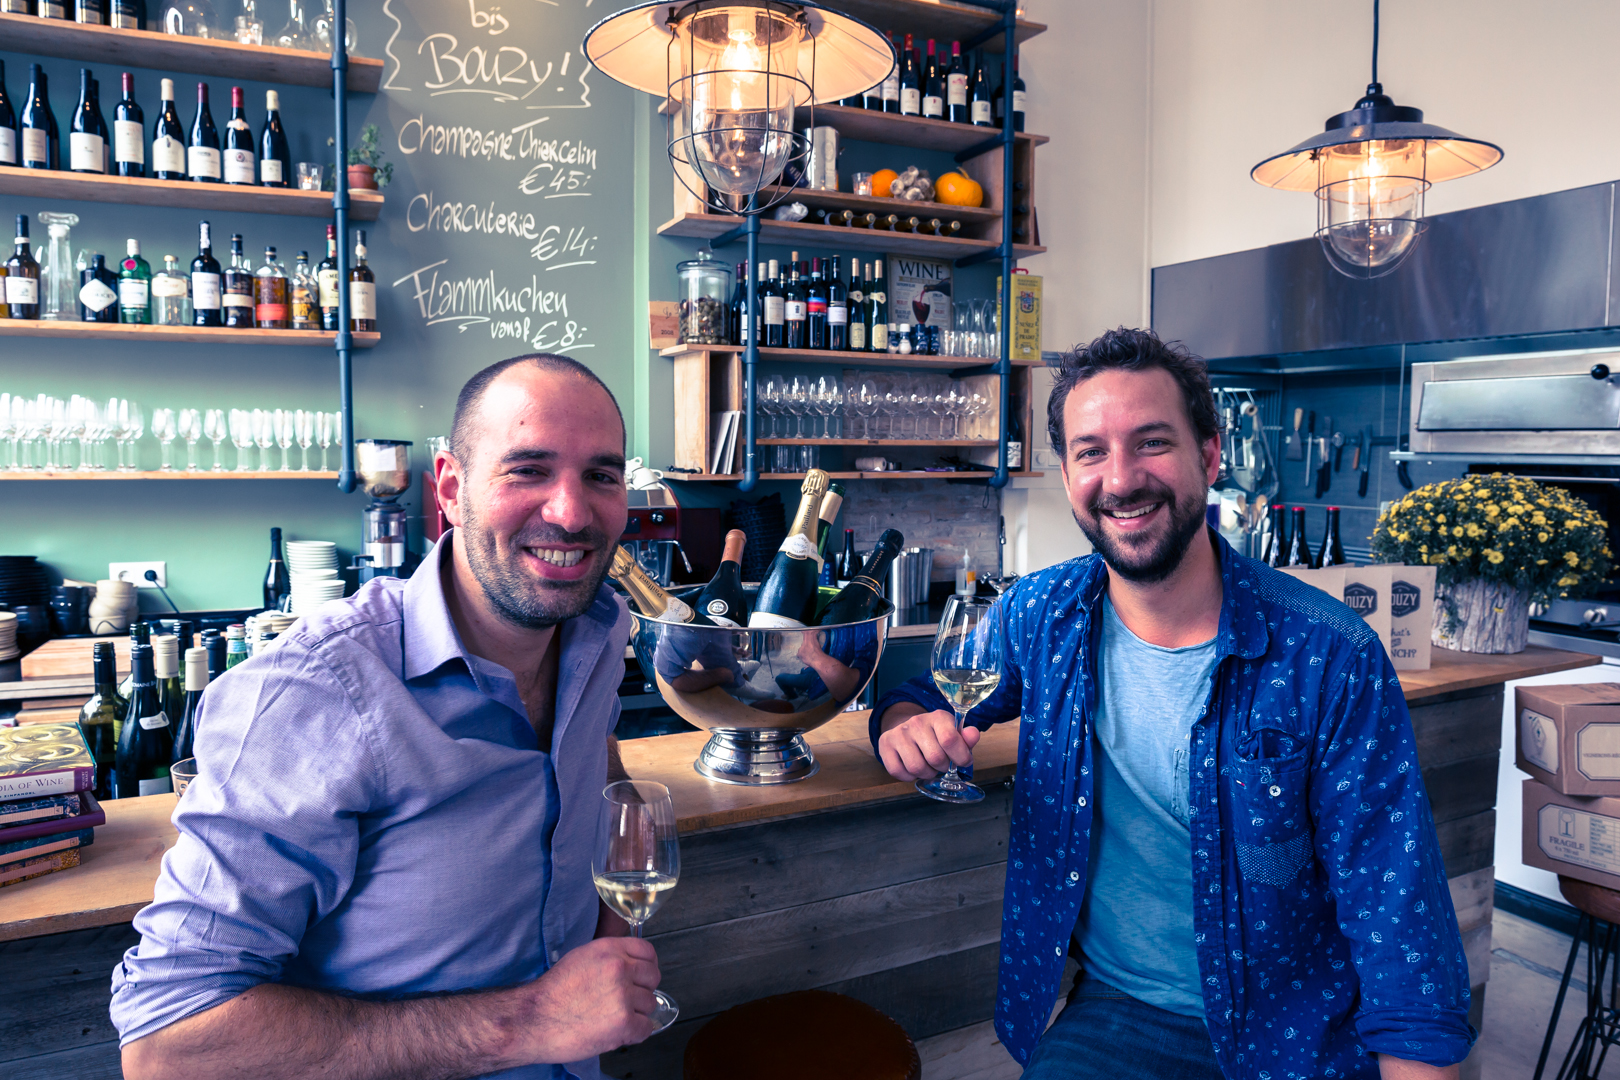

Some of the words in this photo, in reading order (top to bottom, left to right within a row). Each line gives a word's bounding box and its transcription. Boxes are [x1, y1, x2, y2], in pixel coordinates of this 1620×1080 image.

[898, 260, 943, 280] WINE
[801, 504, 814, 530] Paillard
[18, 781, 32, 790] OF
[1549, 836, 1585, 851] FRAGILE
